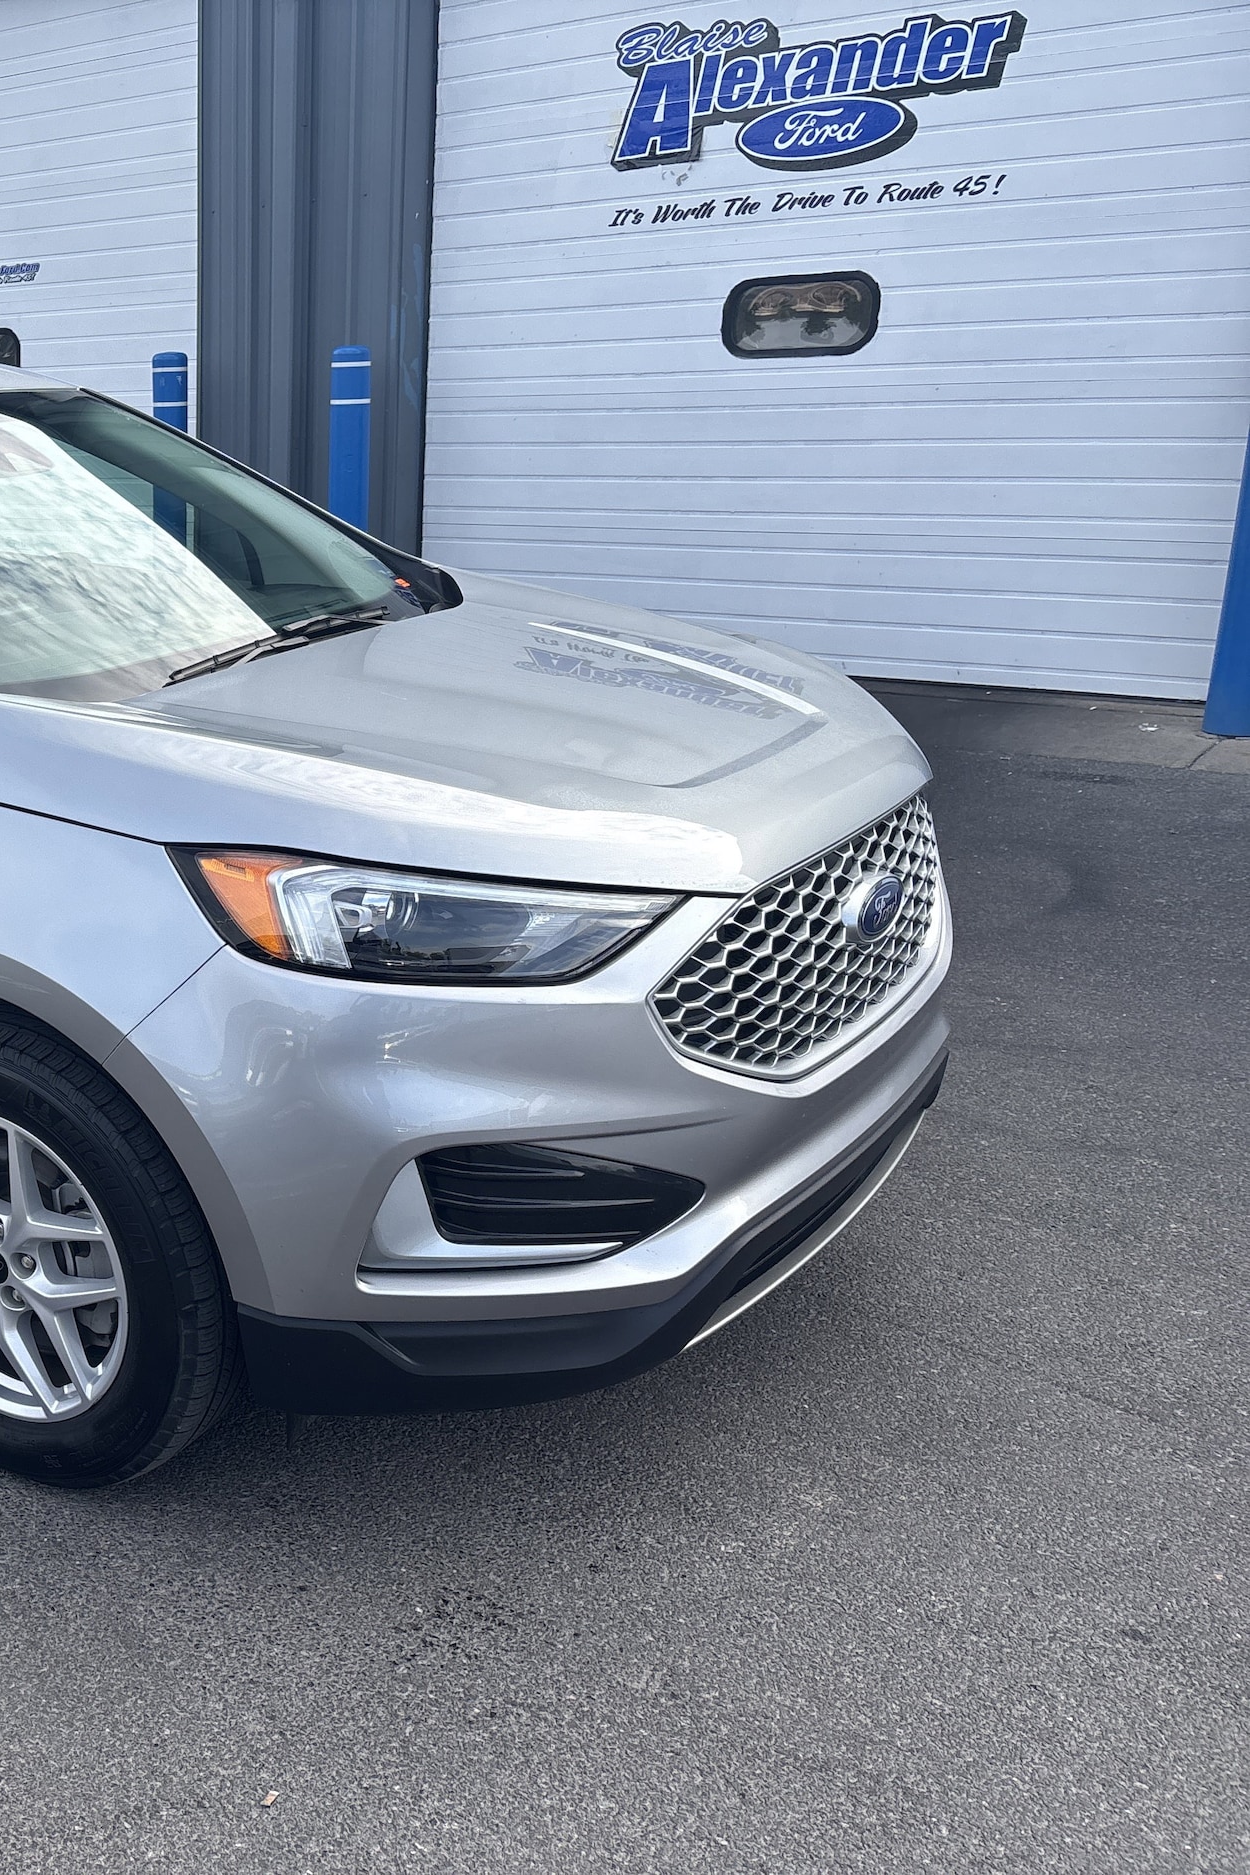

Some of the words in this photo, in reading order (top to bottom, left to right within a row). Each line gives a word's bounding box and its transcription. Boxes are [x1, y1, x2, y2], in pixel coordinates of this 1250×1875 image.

[617, 20, 771, 67] Blaise
[613, 13, 1014, 162] Alexander
[774, 109, 866, 150] Ford
[609, 207, 645, 227] It's
[651, 199, 716, 224] Worth
[724, 195, 761, 217] The
[771, 191, 835, 212] Drive
[842, 185, 869, 206] To
[876, 181, 944, 204] Route
[873, 890, 899, 928] Ford
